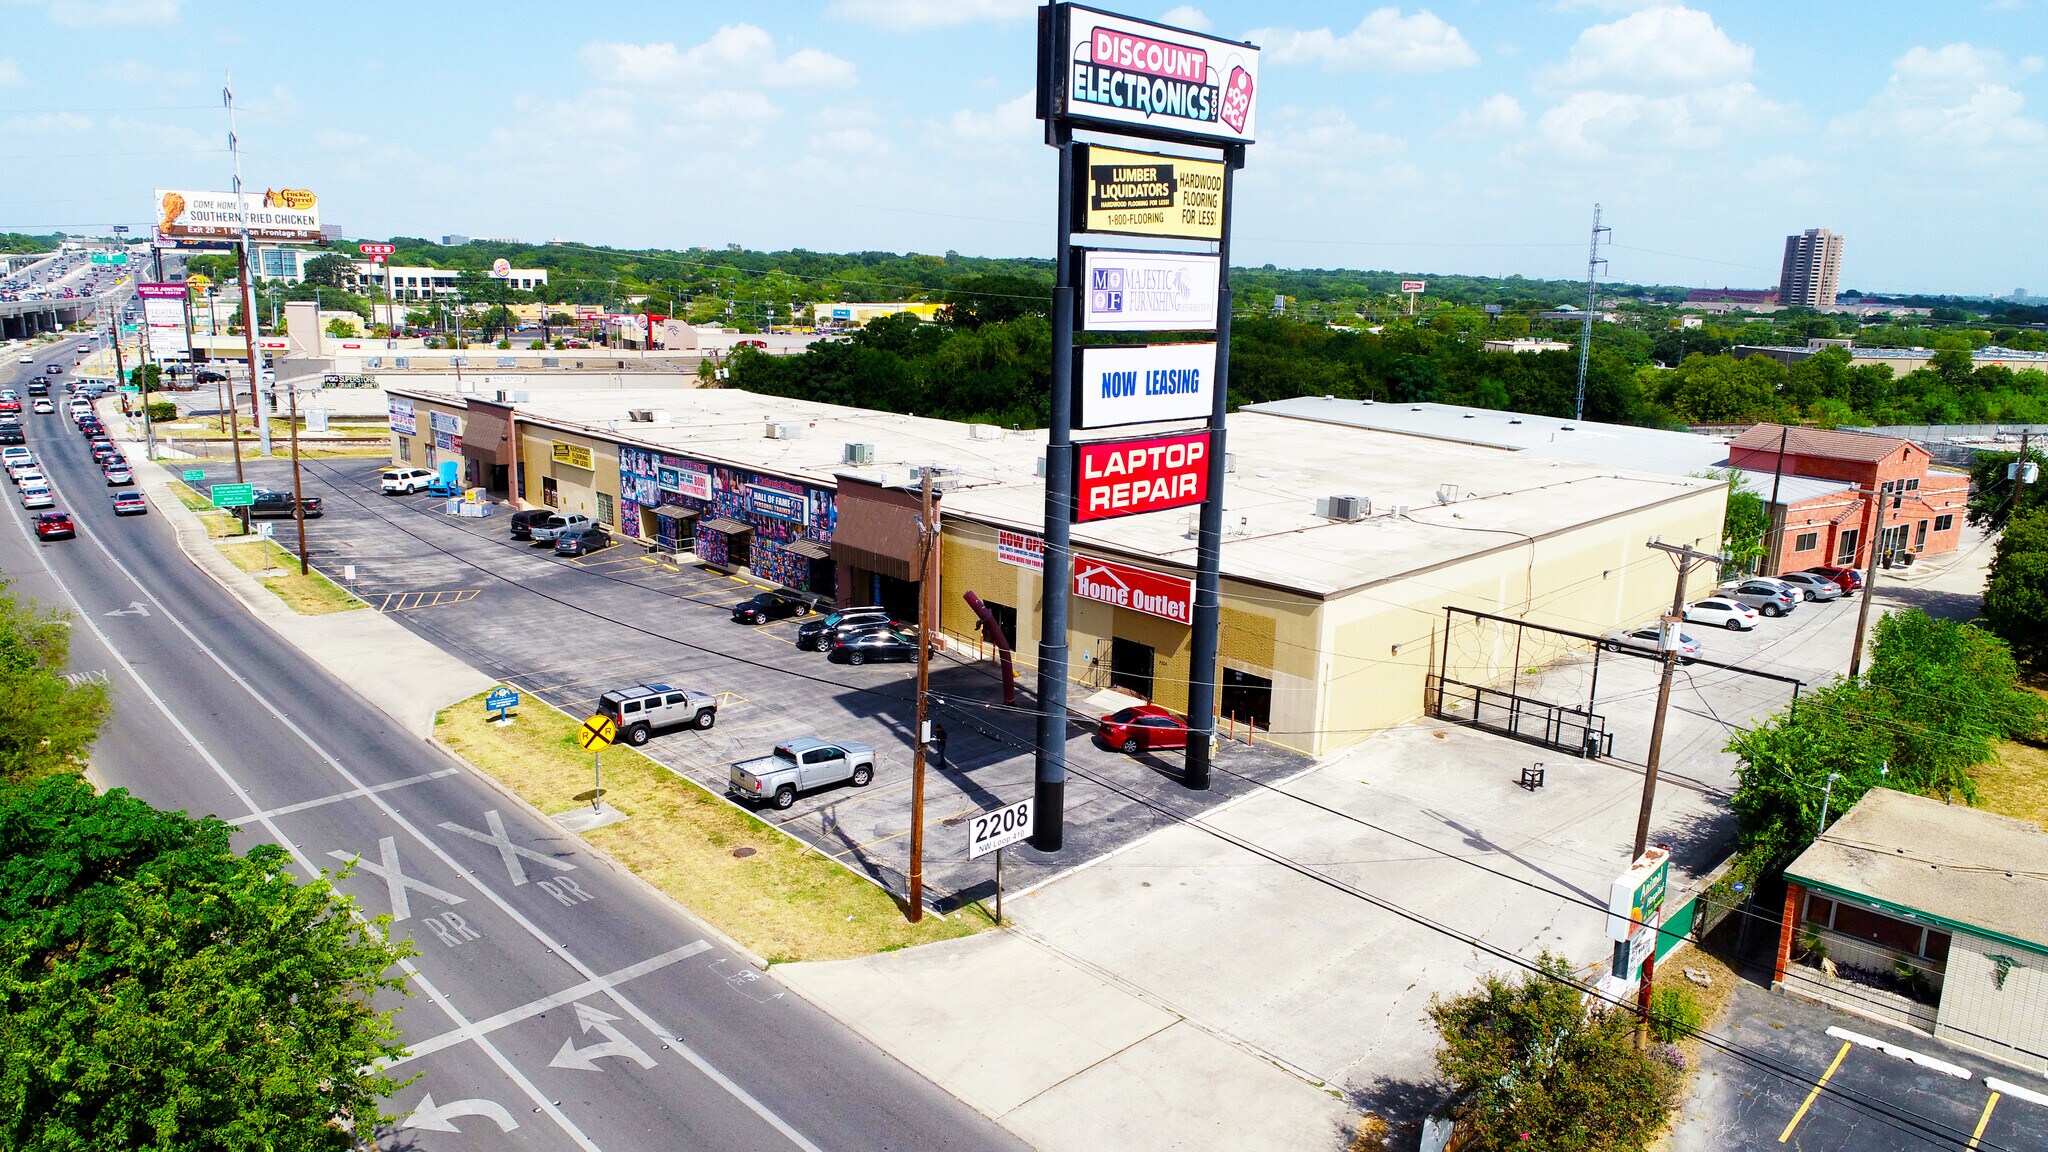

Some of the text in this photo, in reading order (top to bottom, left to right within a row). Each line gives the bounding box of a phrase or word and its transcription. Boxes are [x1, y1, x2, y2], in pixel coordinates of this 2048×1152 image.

[1097, 33, 1204, 79] DISCOUNT
[1075, 63, 1210, 121] ELECTRONICS
[1227, 87, 1248, 112] $99
[1113, 167, 1157, 182] LUMBER
[1179, 172, 1221, 191] HARDWOOD
[281, 189, 311, 200] Cracker
[1100, 183, 1169, 200] LIQUIDATORS
[1183, 191, 1218, 208] FLOORING
[193, 200, 214, 209] COME
[216, 201, 237, 210] HOME
[287, 197, 313, 208] Barrel
[190, 211, 315, 225] SOUTHERN FRIED CHICKEN
[1108, 211, 1164, 226] 1-800-FLOORING
[1182, 209, 1217, 226] FOR LESS!
[187, 226, 204, 234] Exit
[205, 226, 216, 235] 20
[223, 227, 228, 235] 1
[260, 229, 296, 238] Frontage
[297, 230, 308, 238] Rd
[1094, 271, 1108, 290] M
[1124, 269, 1173, 290] MAJESTIC
[1108, 291, 1121, 310] F
[1129, 291, 1180, 312] FURNISHING
[339, 375, 375, 383] SUPERSTORE
[1101, 368, 1200, 399] NOW LEASING
[1085, 442, 1204, 479] LAPTOP
[753, 491, 767, 502] HALL
[767, 494, 775, 504] OF
[775, 496, 791, 508] FAME
[1090, 472, 1198, 512] REPAIR
[1000, 531, 1024, 549] NOW
[1025, 537, 1045, 554] OPE
[1078, 577, 1186, 619] Home Outlet
[582, 727, 612, 740] R R
[975, 803, 1028, 844] 2208
[979, 843, 992, 853] NW
[993, 836, 1011, 848] Loop
[536, 876, 595, 907] RR
[1640, 865, 1664, 901] Animal
[421, 911, 481, 948] RR
